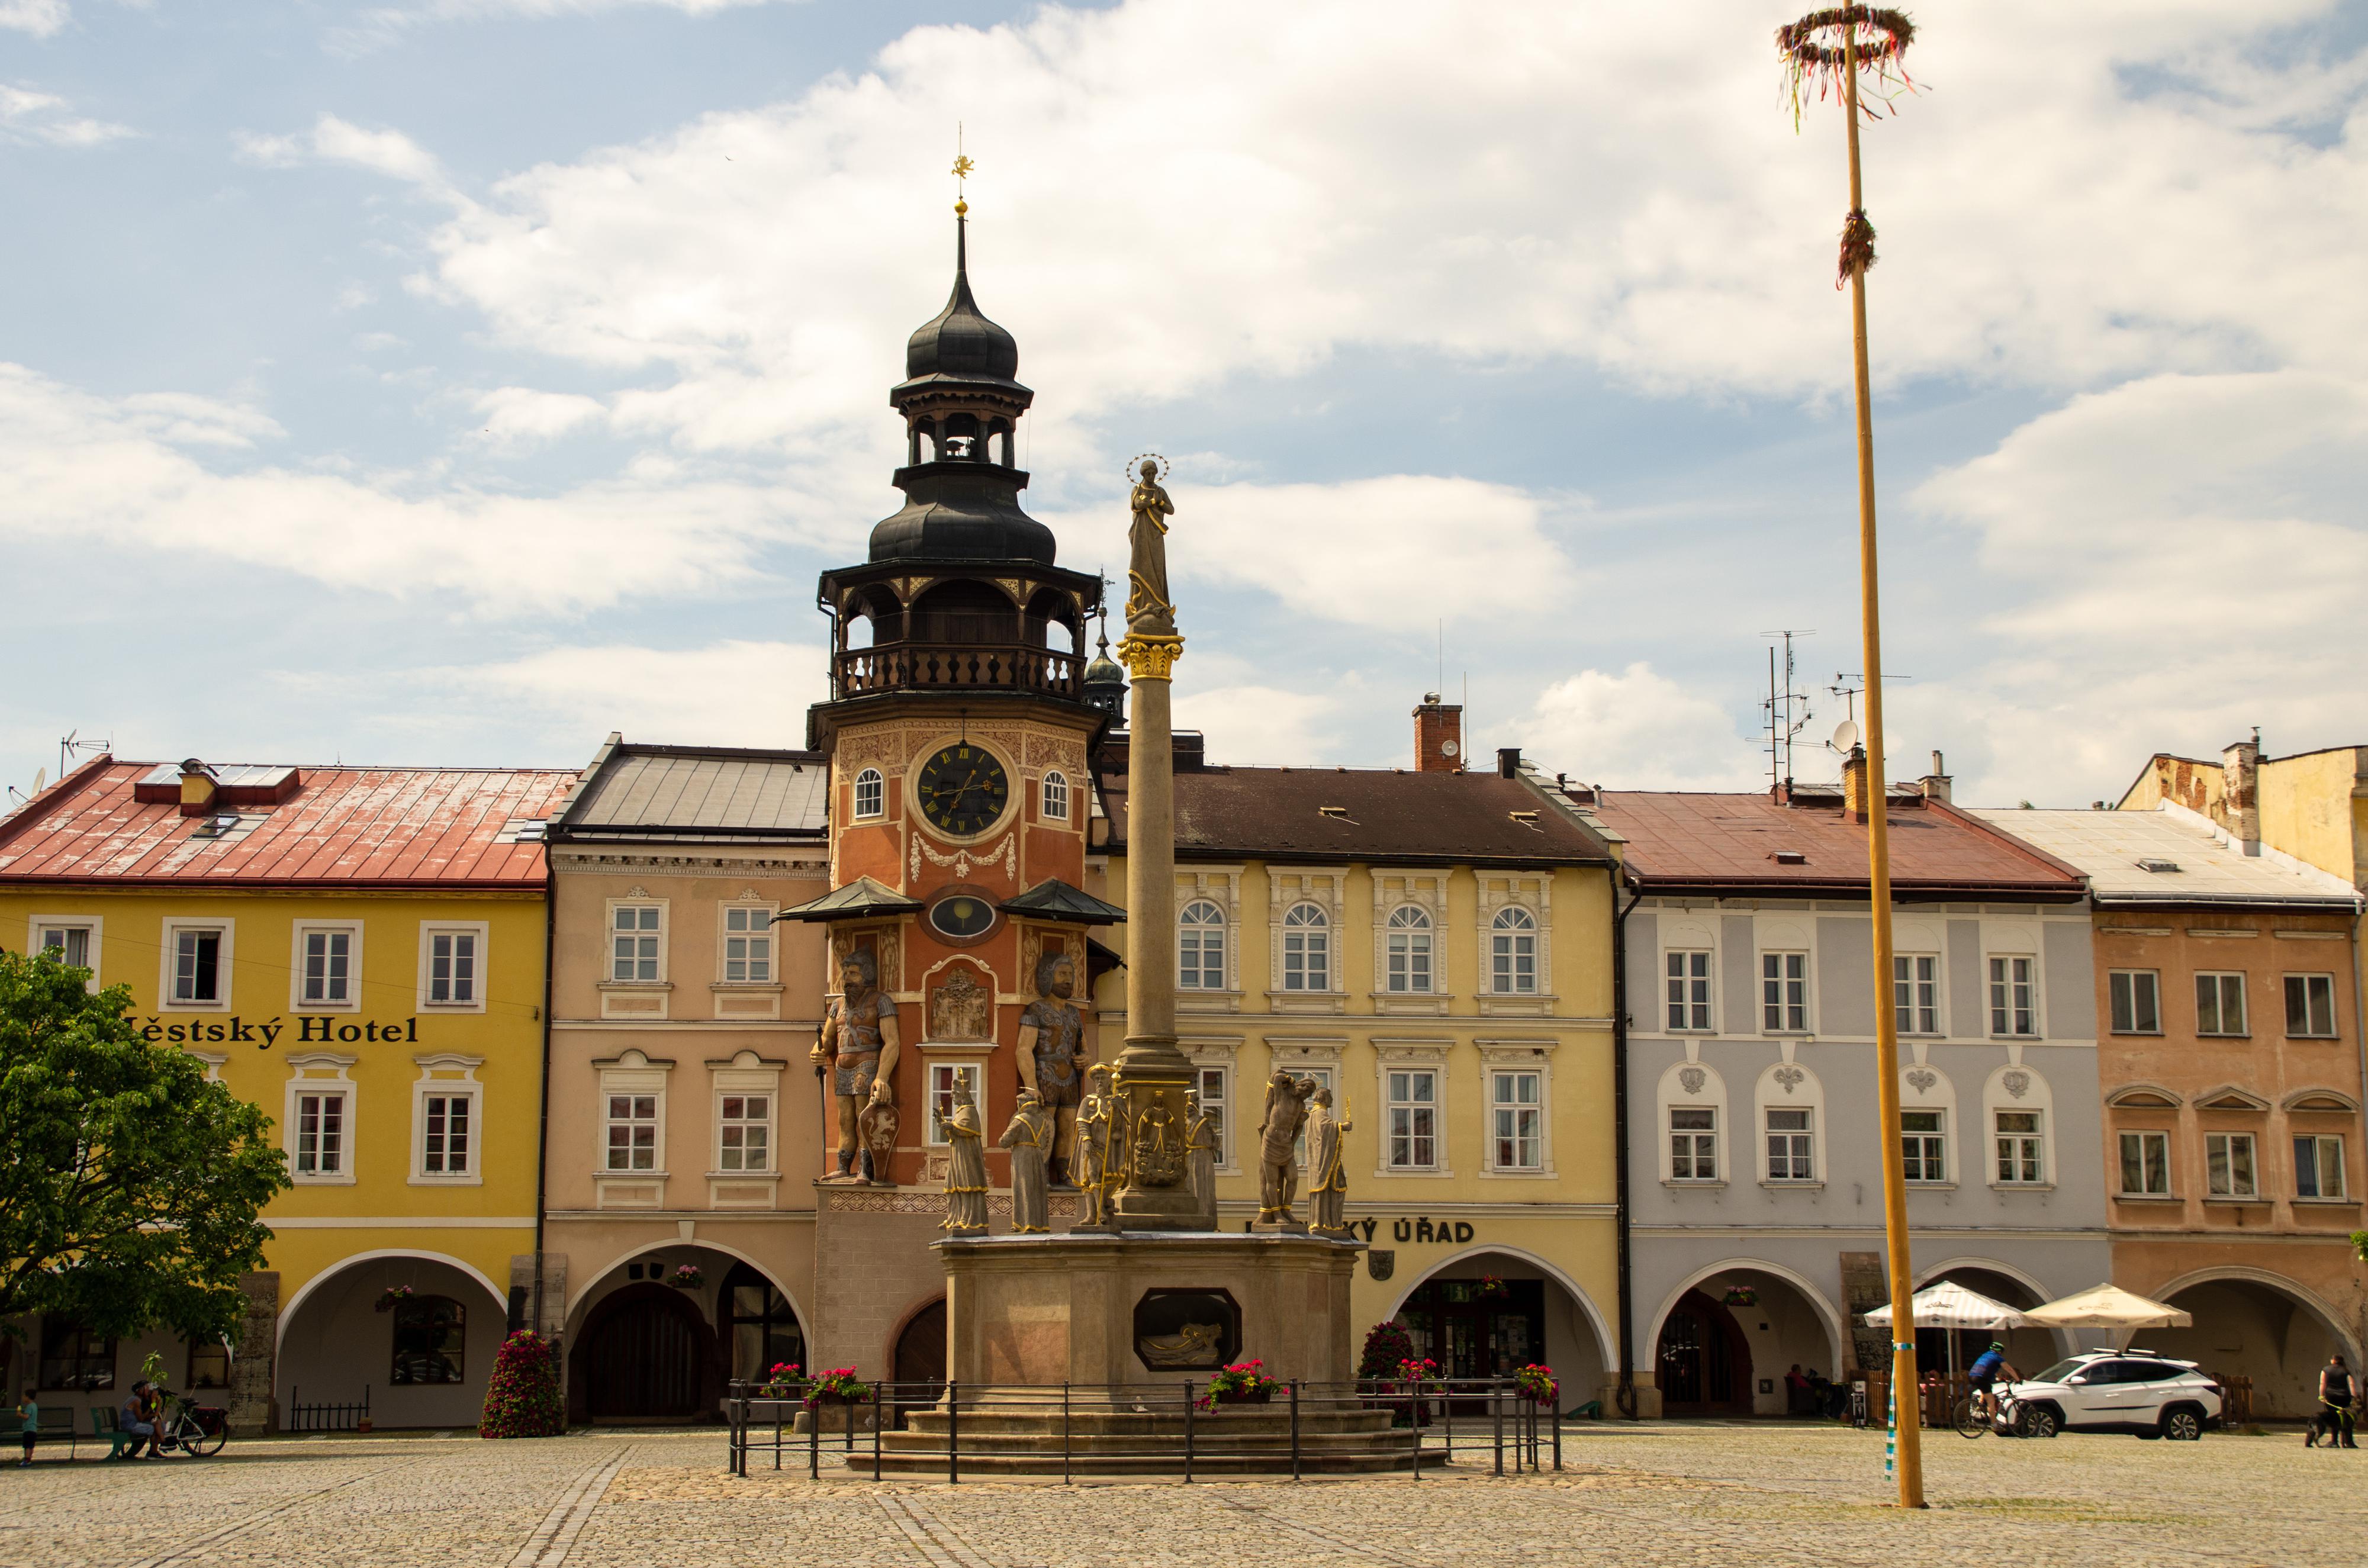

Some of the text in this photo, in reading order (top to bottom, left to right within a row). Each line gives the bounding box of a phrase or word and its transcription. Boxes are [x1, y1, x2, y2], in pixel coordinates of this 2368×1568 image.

[940, 752, 951, 764] XI
[959, 748, 969, 759] XII
[978, 754, 985, 763] I
[926, 766, 938, 775] X
[990, 768, 1000, 777] II
[925, 800, 938, 814] VIII
[940, 815, 951, 828] VII
[958, 820, 965, 832] VI
[297, 1017, 418, 1042] Hotel
[1394, 1216, 1474, 1243] ÚŘAD
